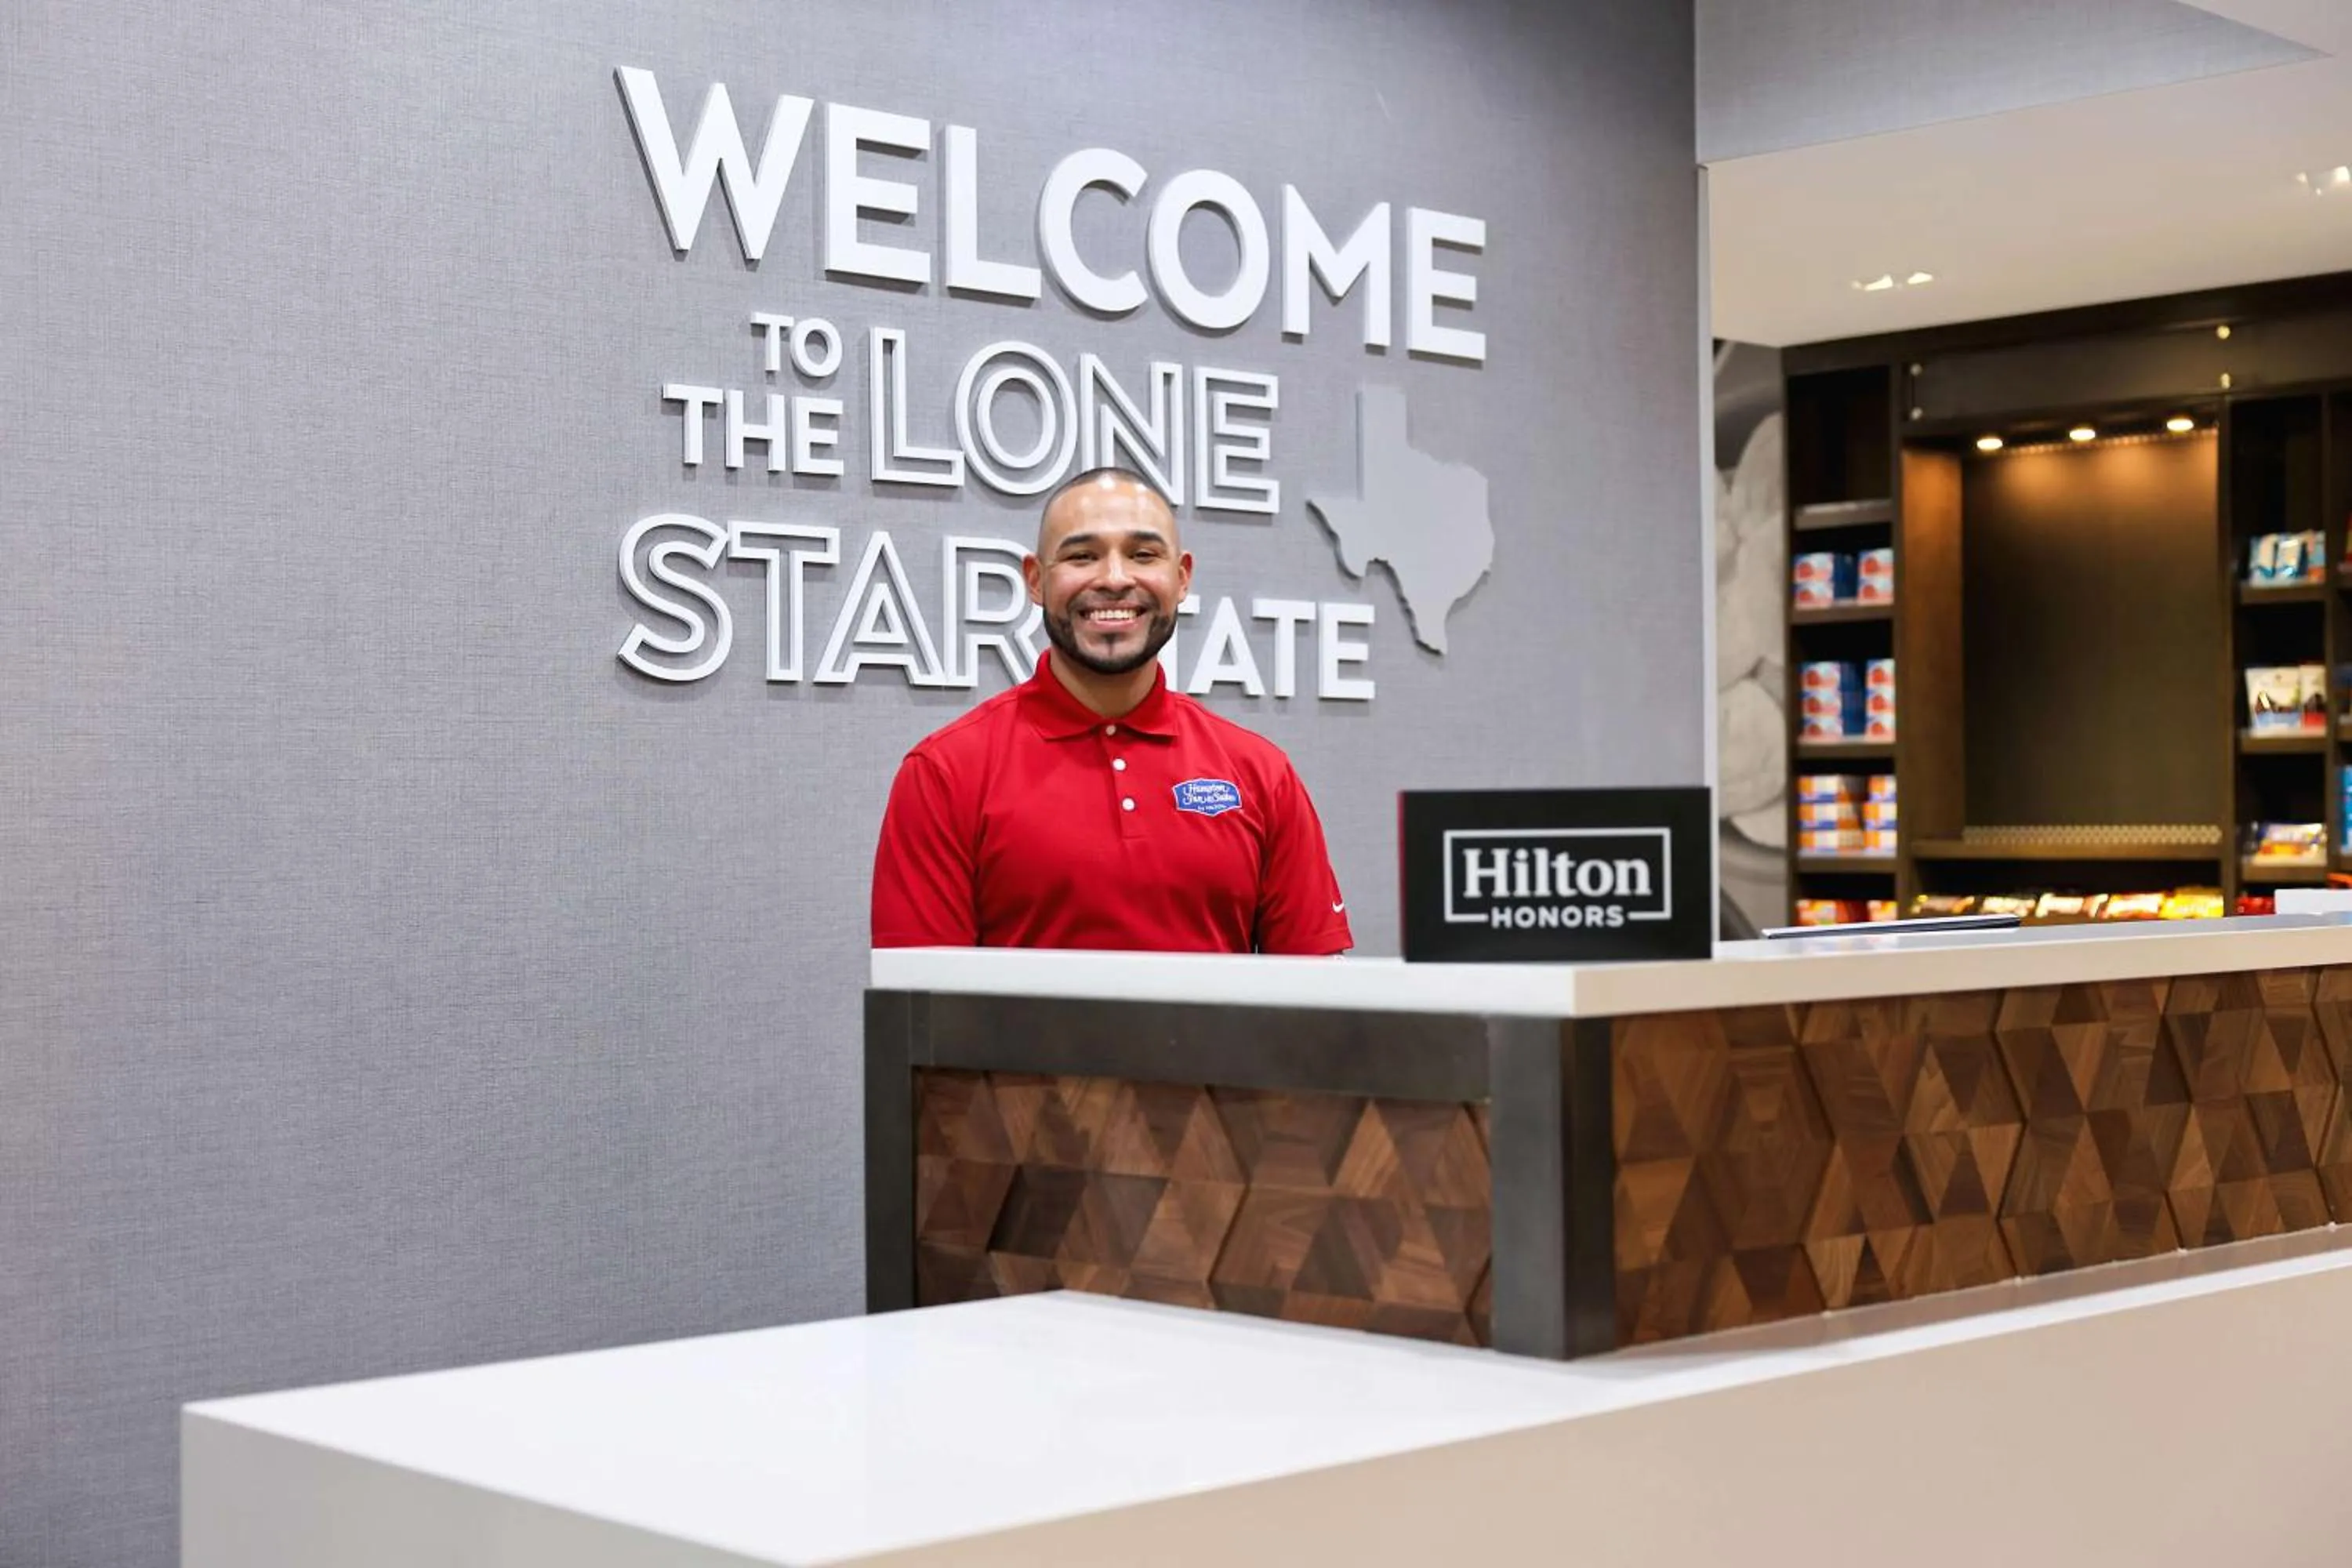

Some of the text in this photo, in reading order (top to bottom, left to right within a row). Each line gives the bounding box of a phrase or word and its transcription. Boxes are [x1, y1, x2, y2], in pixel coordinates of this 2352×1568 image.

[614, 66, 1486, 362] WELCOME
[750, 311, 843, 377] TO
[662, 327, 1280, 514] THE LONE
[617, 514, 1375, 700] STAR ATE
[1463, 848, 1652, 898] Hilton
[1491, 905, 1625, 929] HONORS
